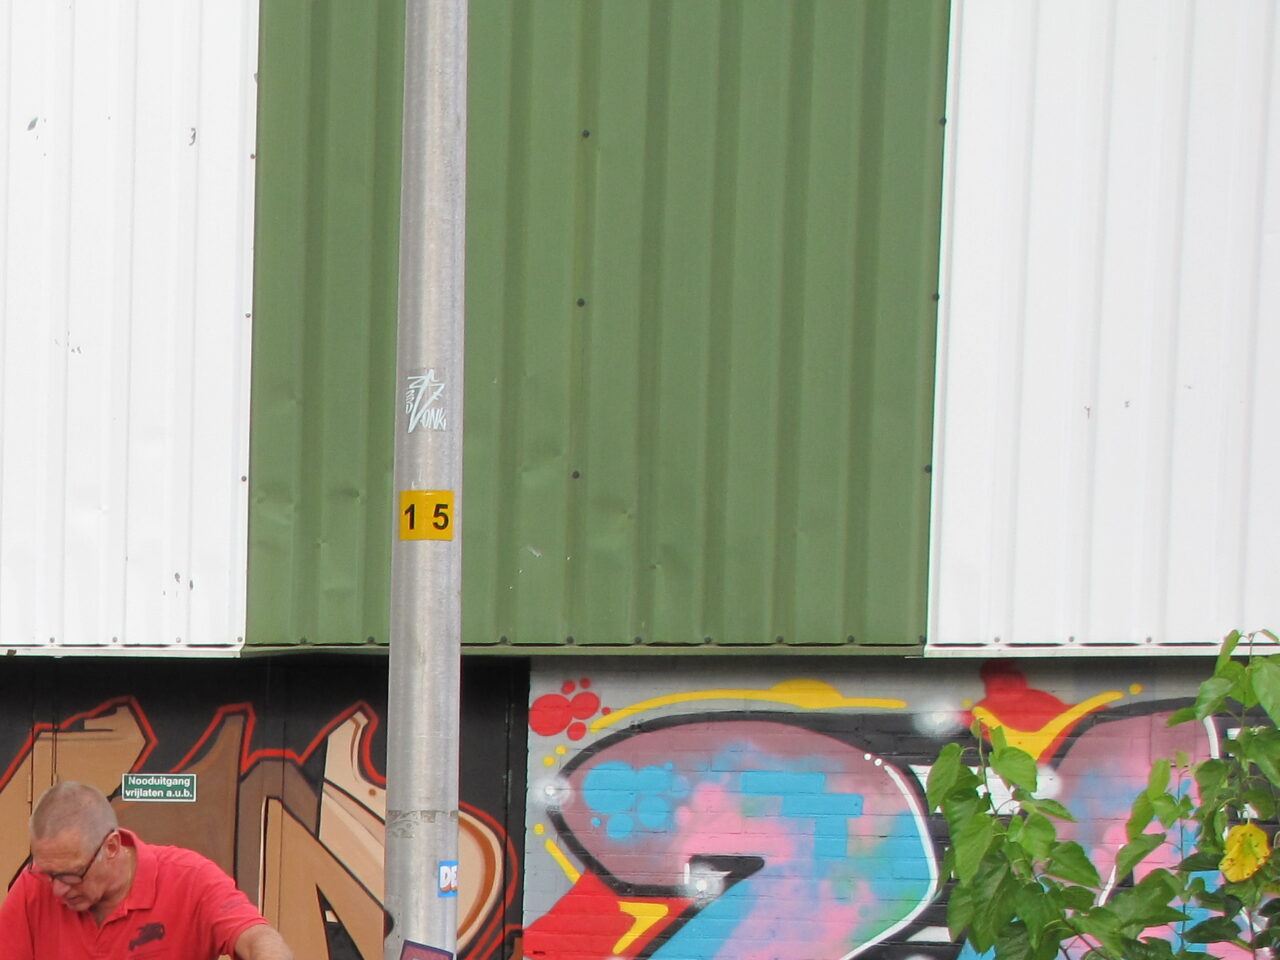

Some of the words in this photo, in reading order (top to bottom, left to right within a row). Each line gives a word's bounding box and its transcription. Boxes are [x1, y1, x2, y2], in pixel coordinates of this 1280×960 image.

[128, 776, 191, 787] Nooduitgang
[125, 788, 164, 798] vrijlaten
[166, 788, 193, 797] a.u.b.
